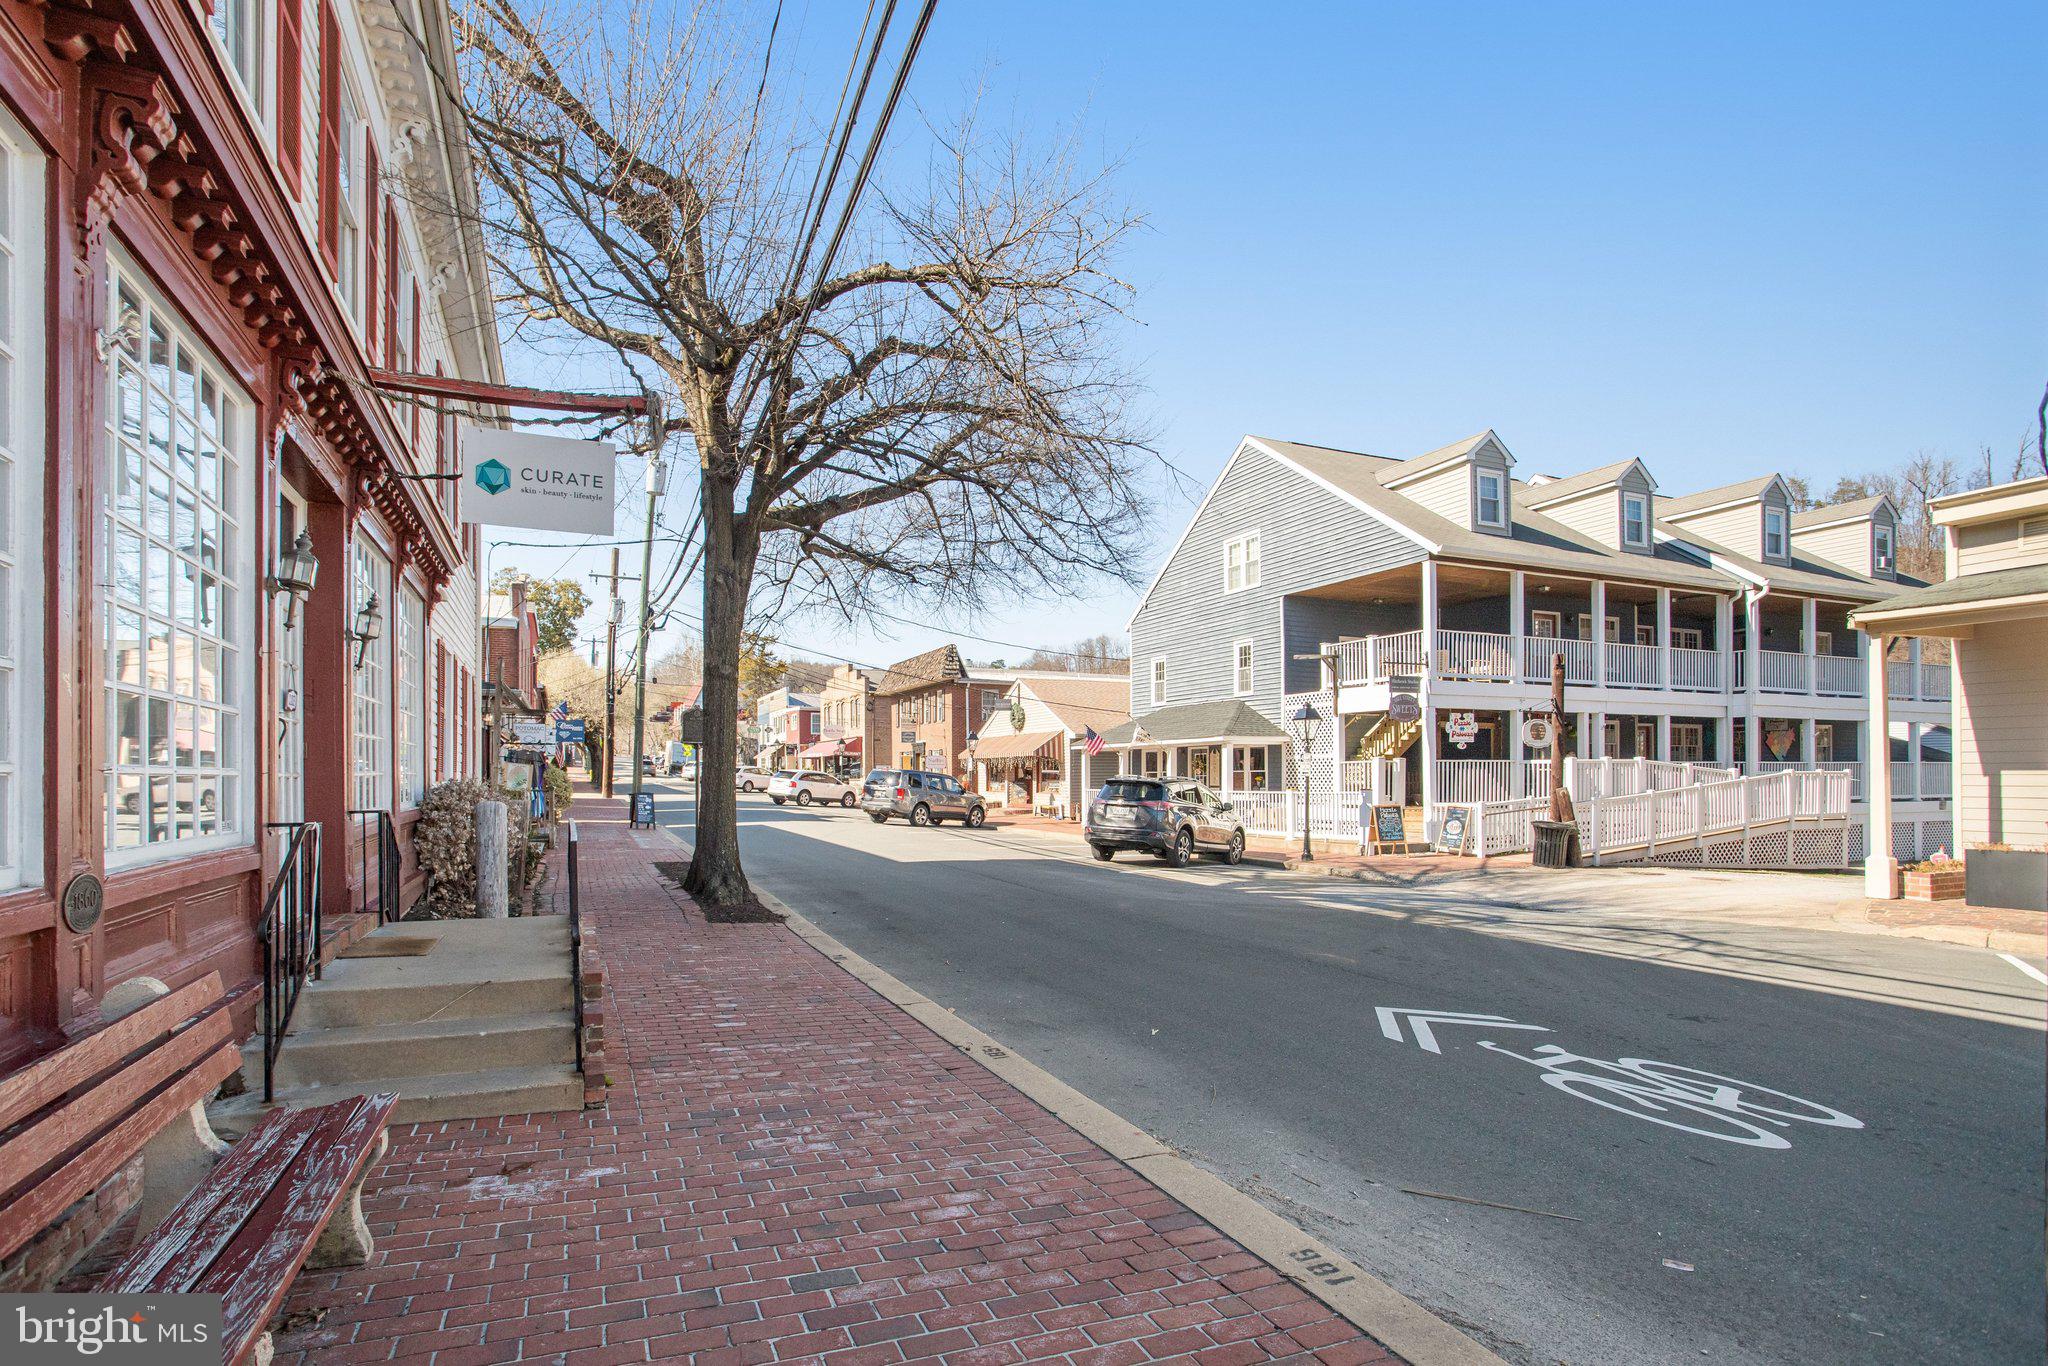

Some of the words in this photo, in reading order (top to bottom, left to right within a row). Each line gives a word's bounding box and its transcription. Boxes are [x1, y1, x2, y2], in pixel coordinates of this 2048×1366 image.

[521, 467, 603, 489] CURATE
[543, 488, 567, 499] beauty
[573, 491, 603, 502] lifestyle
